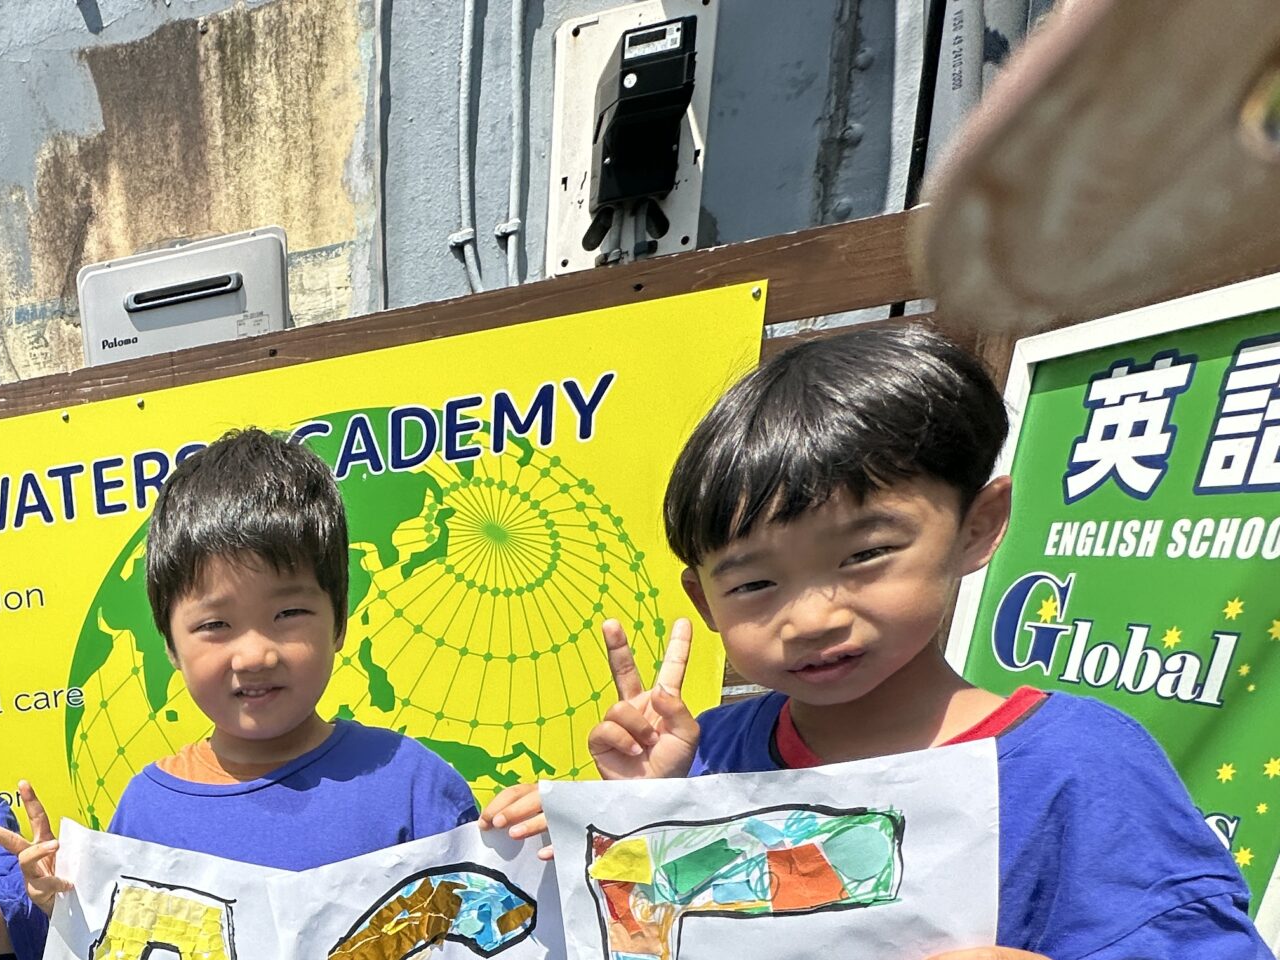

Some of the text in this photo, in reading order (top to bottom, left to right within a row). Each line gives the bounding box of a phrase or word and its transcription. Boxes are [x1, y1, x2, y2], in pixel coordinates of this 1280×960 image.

[101, 336, 138, 350] Paloma
[289, 373, 616, 478] ADEMY
[1044, 518, 1163, 558] ENGLISH
[992, 571, 1241, 707] Global
[15, 686, 85, 712] care
